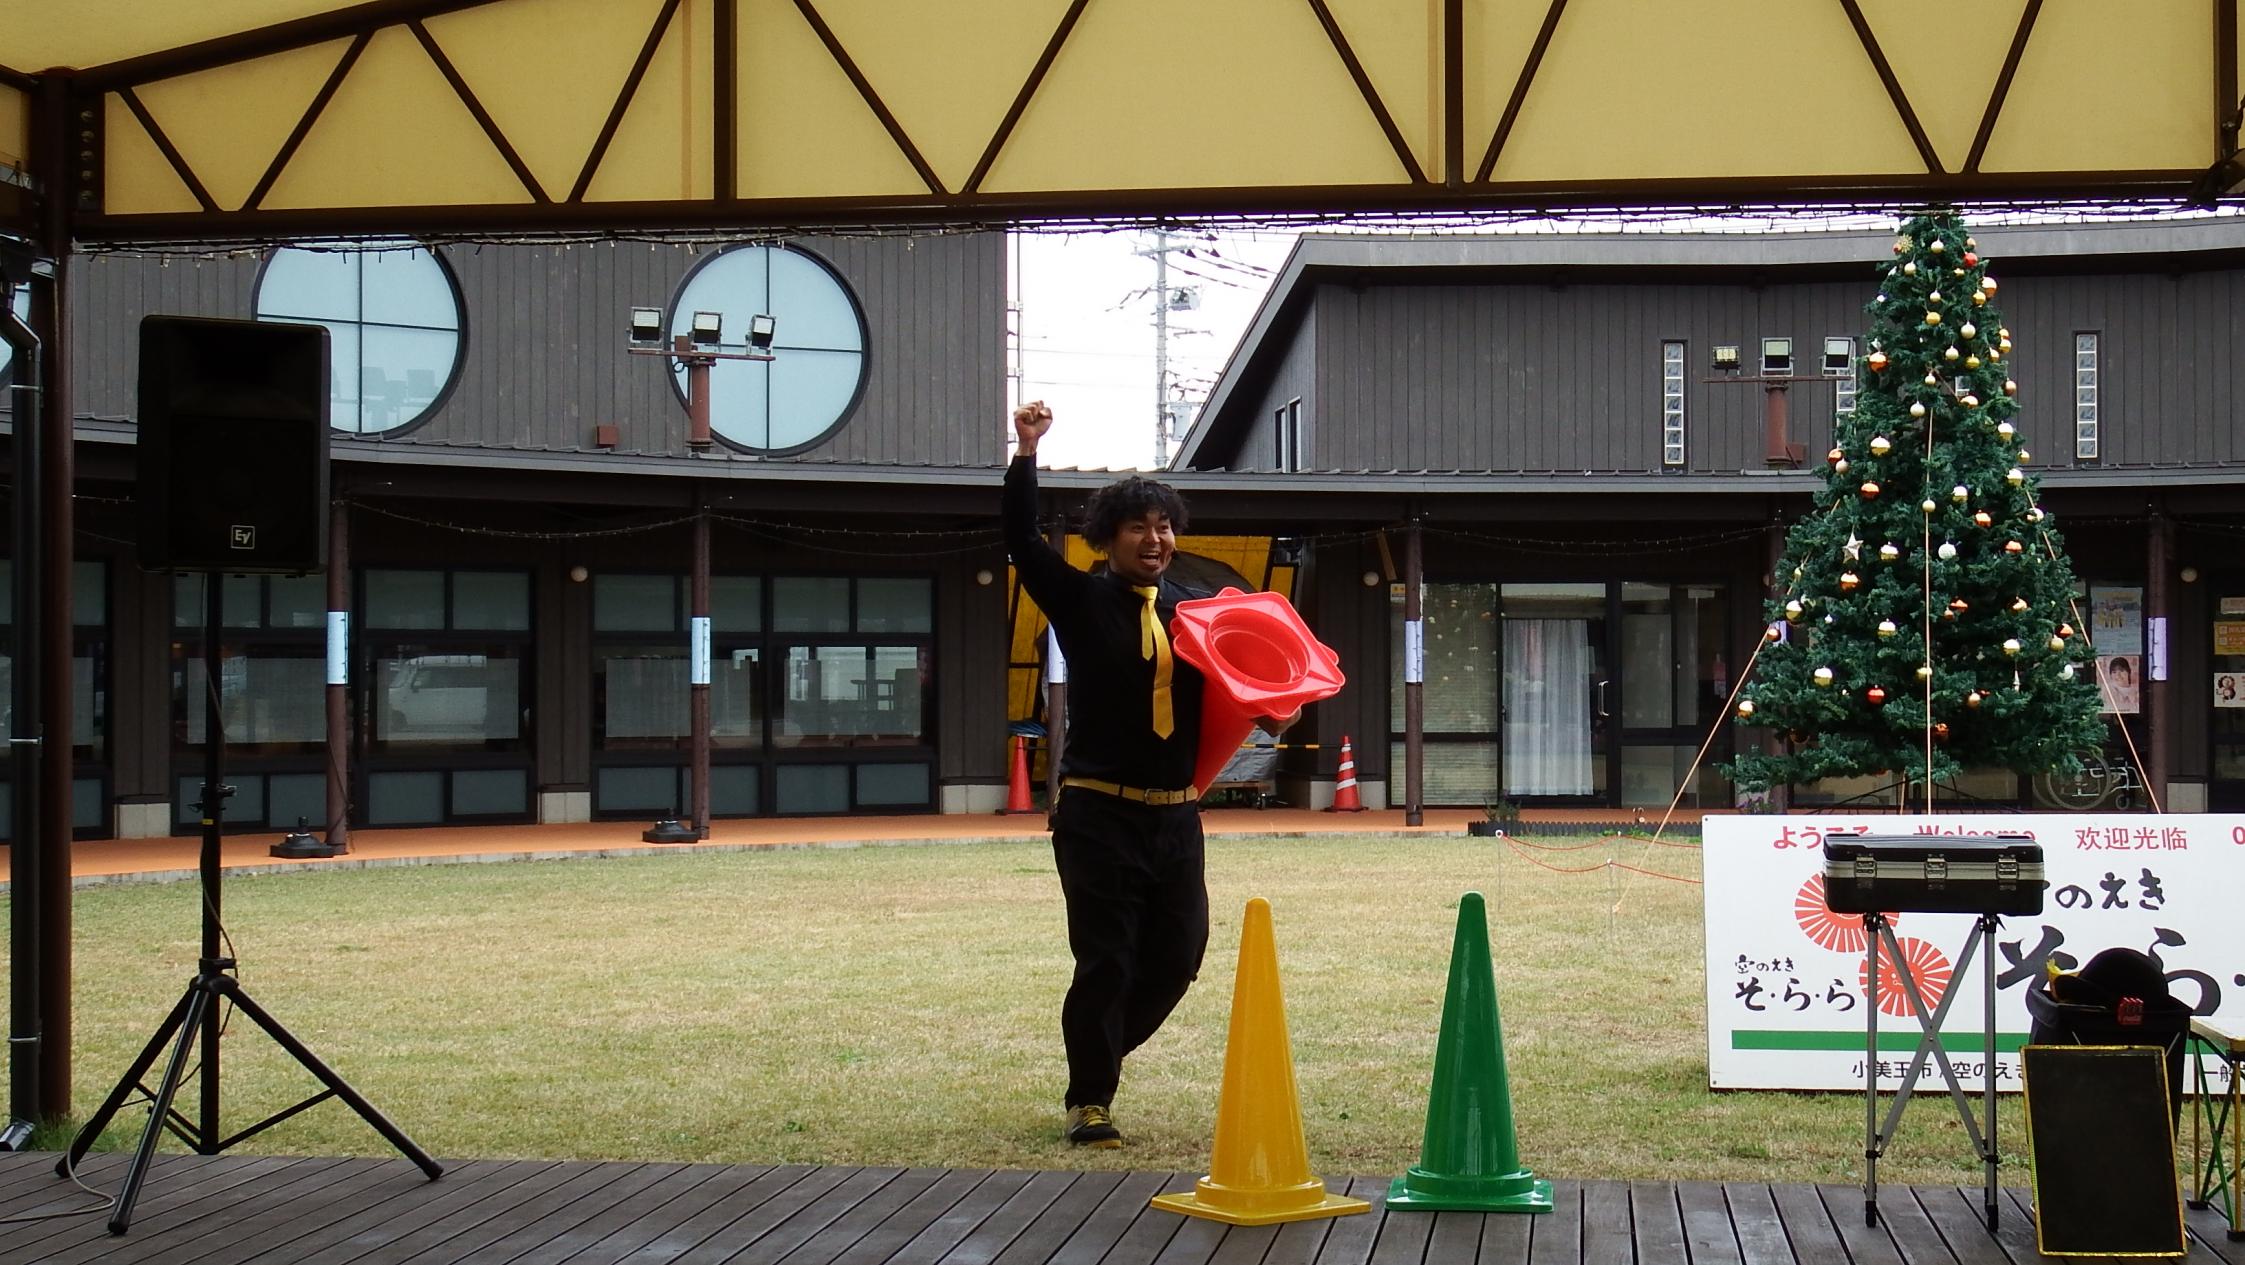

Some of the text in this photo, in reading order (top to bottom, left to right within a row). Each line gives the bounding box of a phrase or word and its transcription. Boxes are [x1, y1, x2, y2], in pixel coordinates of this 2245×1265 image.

[2075, 826, 2188, 851] 欢迎光临
[2042, 867, 2165, 911] のえき
